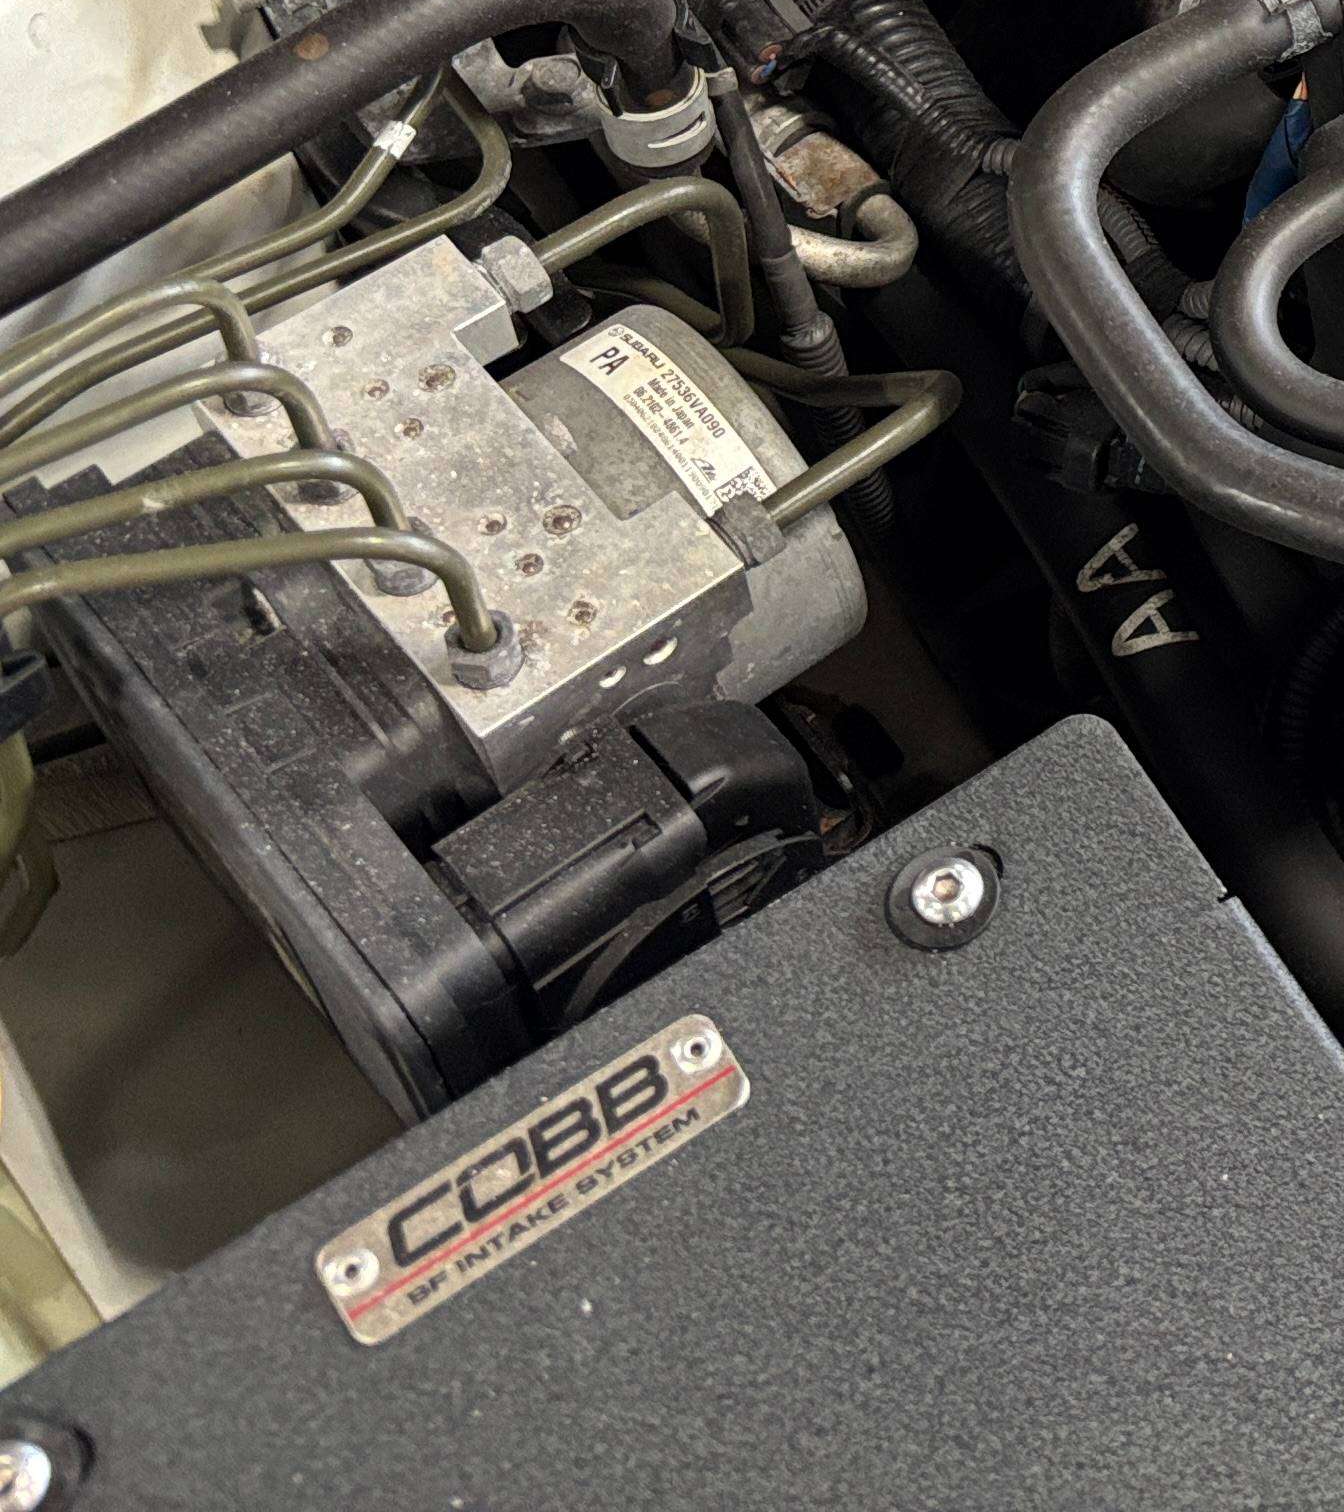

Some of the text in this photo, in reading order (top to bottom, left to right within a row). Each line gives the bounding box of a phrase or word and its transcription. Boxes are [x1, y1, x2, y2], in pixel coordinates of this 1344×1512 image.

[589, 346, 630, 376] PA
[619, 333, 665, 370] SUBARU
[660, 369, 726, 440] 27536VA090
[386, 1054, 671, 1269] COBB
[455, 1194, 570, 1276] INTAKE
[576, 1106, 702, 1196] SYSTEM
